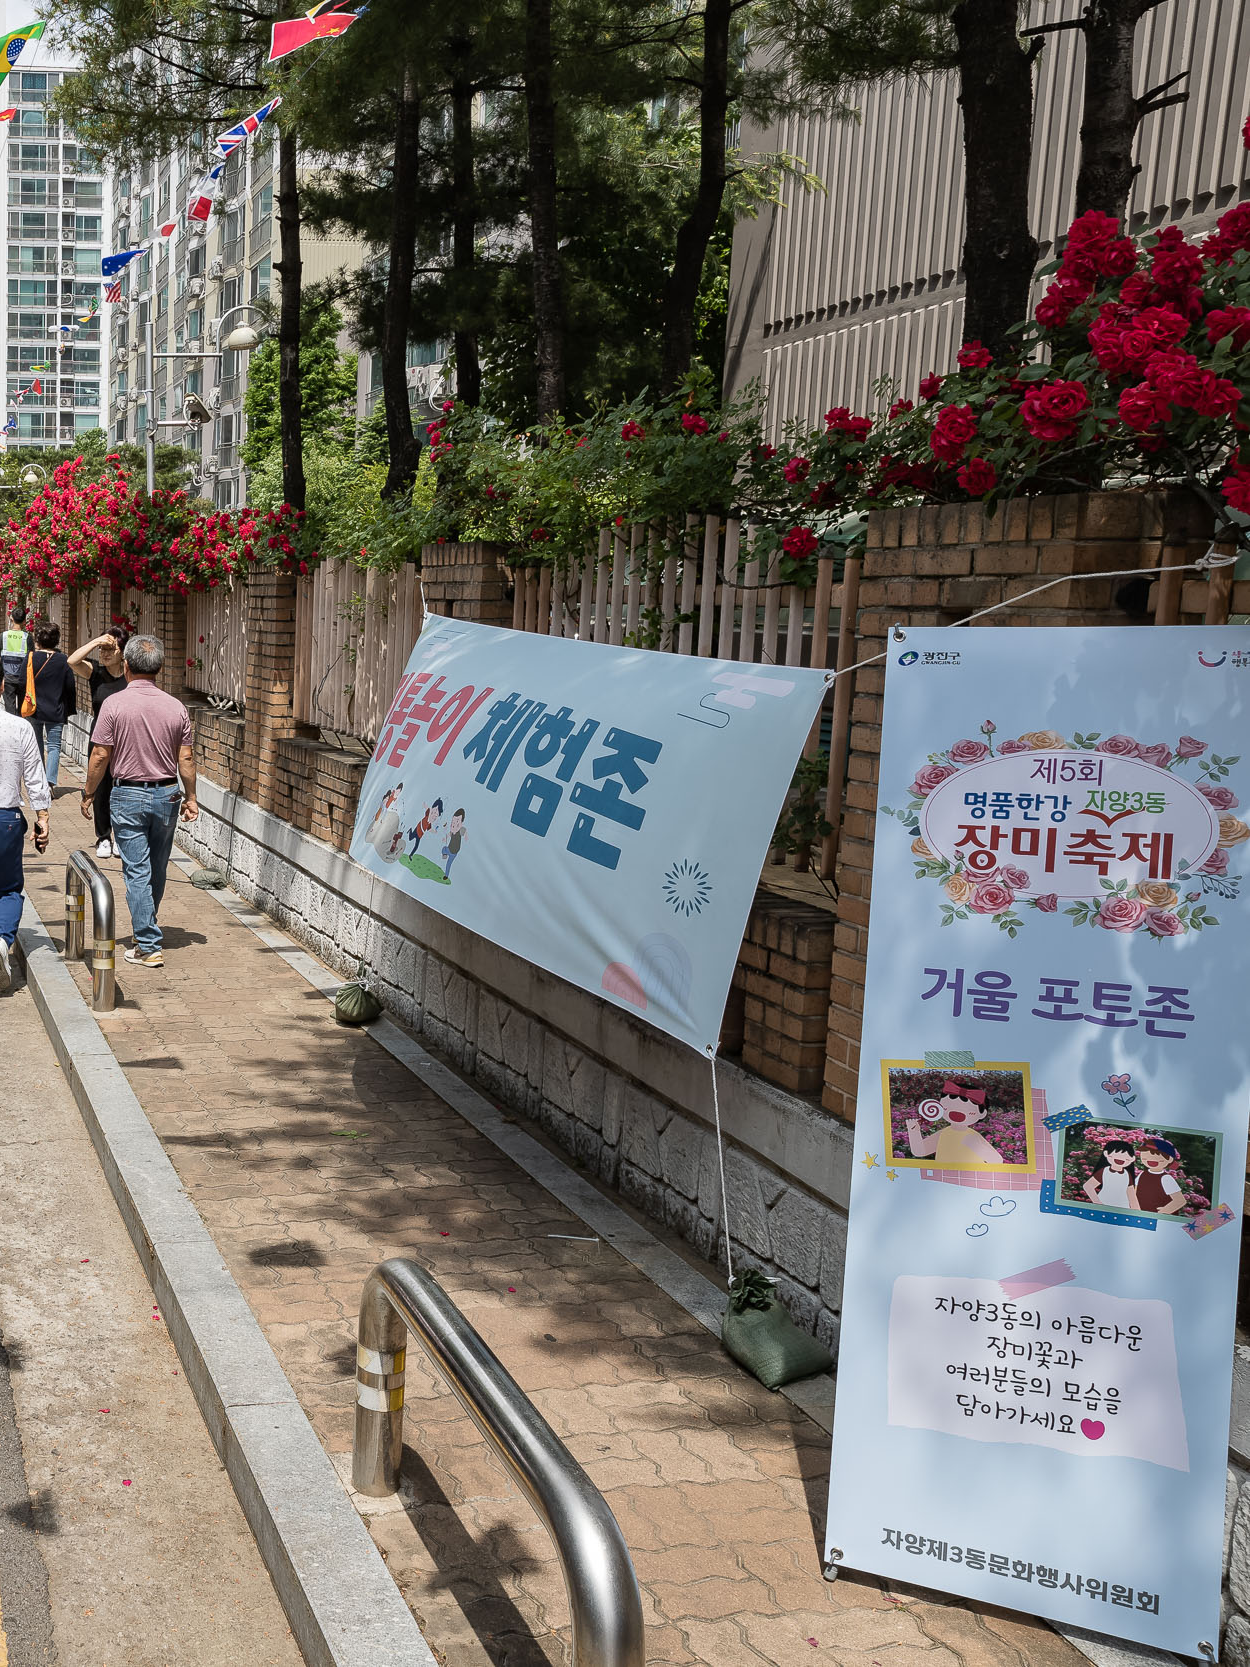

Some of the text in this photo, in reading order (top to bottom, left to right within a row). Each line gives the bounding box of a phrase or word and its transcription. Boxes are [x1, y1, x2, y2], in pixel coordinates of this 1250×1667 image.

[922, 651, 961, 661] 광진구
[372, 671, 663, 871] 통놀이 체험존
[1030, 757, 1104, 787] 제5회
[963, 789, 1167, 823] 명품한강 자양3동
[953, 824, 1174, 881] 장미축제
[921, 967, 1195, 1040] 거울 포토존
[934, 1296, 1143, 1352] 자양3동의 아름다운
[987, 1336, 1084, 1370] 장미꽃과
[946, 1362, 1122, 1415] 여러분들의 모습을
[956, 1394, 1077, 1435] 담아가세요
[880, 1527, 1161, 1616] 자양제3동문화행사위원회
